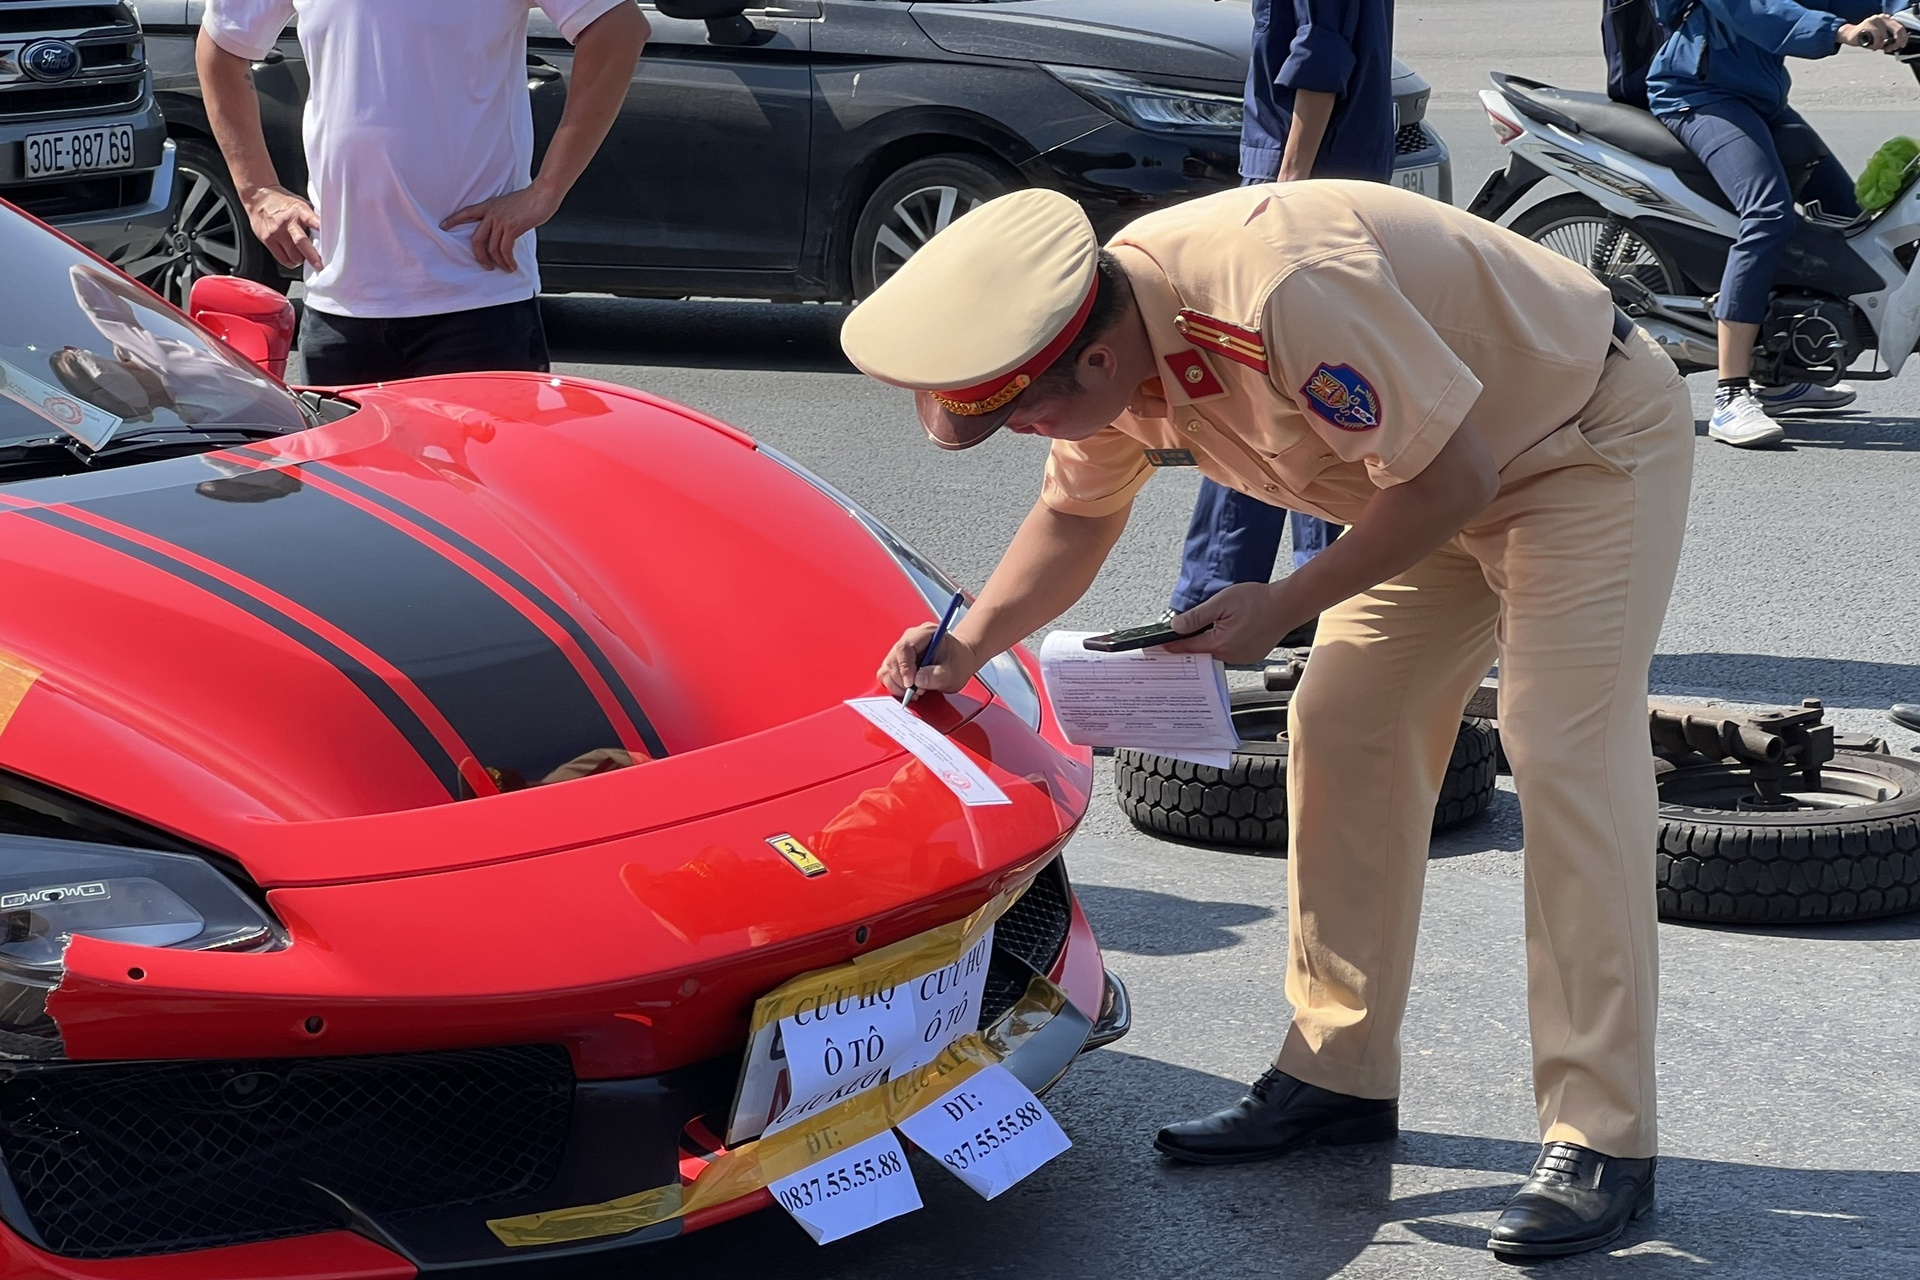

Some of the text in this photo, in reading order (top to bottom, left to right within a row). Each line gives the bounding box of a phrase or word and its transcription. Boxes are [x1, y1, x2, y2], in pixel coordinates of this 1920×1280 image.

[42, 49, 70, 68] Ford
[30, 130, 130, 173] 30E-887.69
[1334, 384, 1366, 424] CSGT
[965, 935, 986, 978] HỘ
[794, 971, 895, 1026] CỨU HỘ
[924, 991, 968, 1042] Ô TÔ
[824, 1025, 884, 1076] Ô TÔ
[941, 1093, 983, 1122] ĐT:
[805, 1126, 842, 1155] ĐT:
[780, 1150, 902, 1213] 0837.55.55.88
